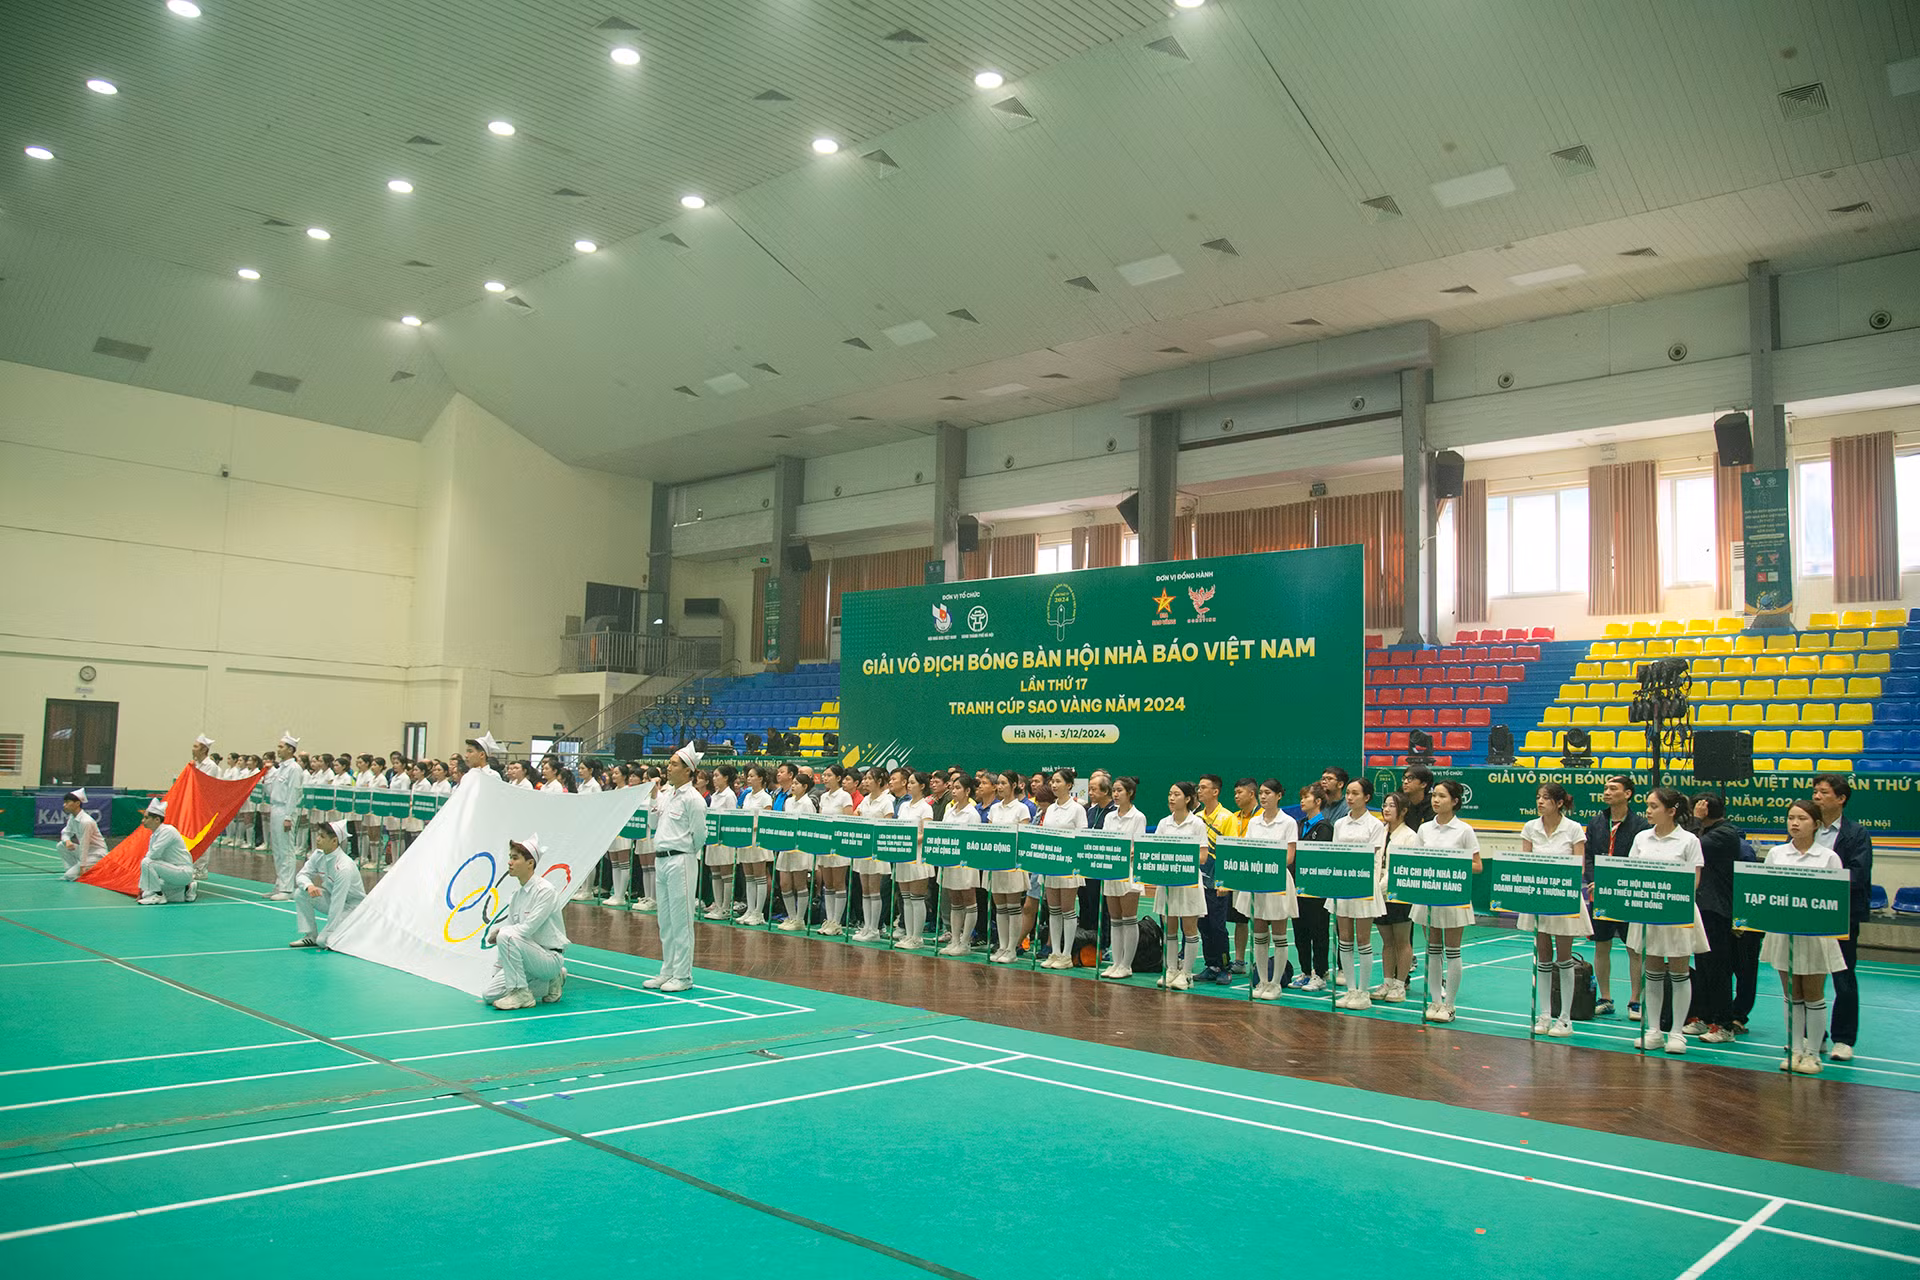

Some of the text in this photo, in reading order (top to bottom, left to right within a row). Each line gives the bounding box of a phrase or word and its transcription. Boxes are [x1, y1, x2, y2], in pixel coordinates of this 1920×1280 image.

[1170, 574, 1176, 582] VỊ
[1196, 570, 1213, 578] HÀNH
[862, 636, 1316, 677] GIẢI VÔ ĐỊCH BÓNG BÀN HỘI NHÀ BÁO VIỆT NAM
[1020, 674, 1088, 693] LẦN THỨ 17
[948, 694, 1186, 715] TRANH CÚP SAO VÀNG NĂM 2024
[1014, 729, 1026, 738] Hà
[1028, 729, 1046, 740] Nội,
[1048, 730, 1052, 738] 1
[1060, 728, 1106, 739] 3/12/2024
[1488, 770, 1514, 783] GIẢI
[1517, 770, 1536, 783] VÔ
[1753, 774, 1789, 791] VIỆT
[1793, 777, 1814, 788] NA
[1874, 777, 1912, 791] THỨ
[1732, 794, 1802, 807] NĂM 202
[1520, 807, 1536, 816] Thời
[1858, 819, 1891, 829] Hà Nội
[966, 841, 1011, 853] BÁO LAO ĐỘNG
[1140, 852, 1150, 861] TẠP
[1151, 852, 1160, 860] CHÍ
[1224, 859, 1238, 870] BÁO
[1240, 860, 1249, 871] HÀ
[1251, 861, 1263, 874] NỘI
[1300, 868, 1308, 876] TẠP
[1309, 867, 1317, 875] CHÍ
[1393, 865, 1467, 880] LIÊN CHI HỘI NHÀ BÁO
[1396, 878, 1462, 892] NGÀNH NGÂN HÀNG
[1500, 874, 1572, 887] CHI HỘI NHÀ BÁO TẠP CHÍ
[1617, 879, 1671, 890] CHI HỘI NHÀ BÁO
[1493, 884, 1513, 892] DOANH
[1514, 885, 1535, 895] NGHIỆP
[1542, 887, 1565, 897] THƯƠNG
[1567, 890, 1579, 899] MẠI
[1599, 887, 1612, 895] BÁO
[1613, 888, 1632, 897] THIẾU
[1633, 889, 1649, 898] NIÊN
[1667, 894, 1690, 902] PHONG
[1631, 900, 1643, 908] NHI
[1744, 893, 1838, 911] TẠP CHÍ DA CAM
